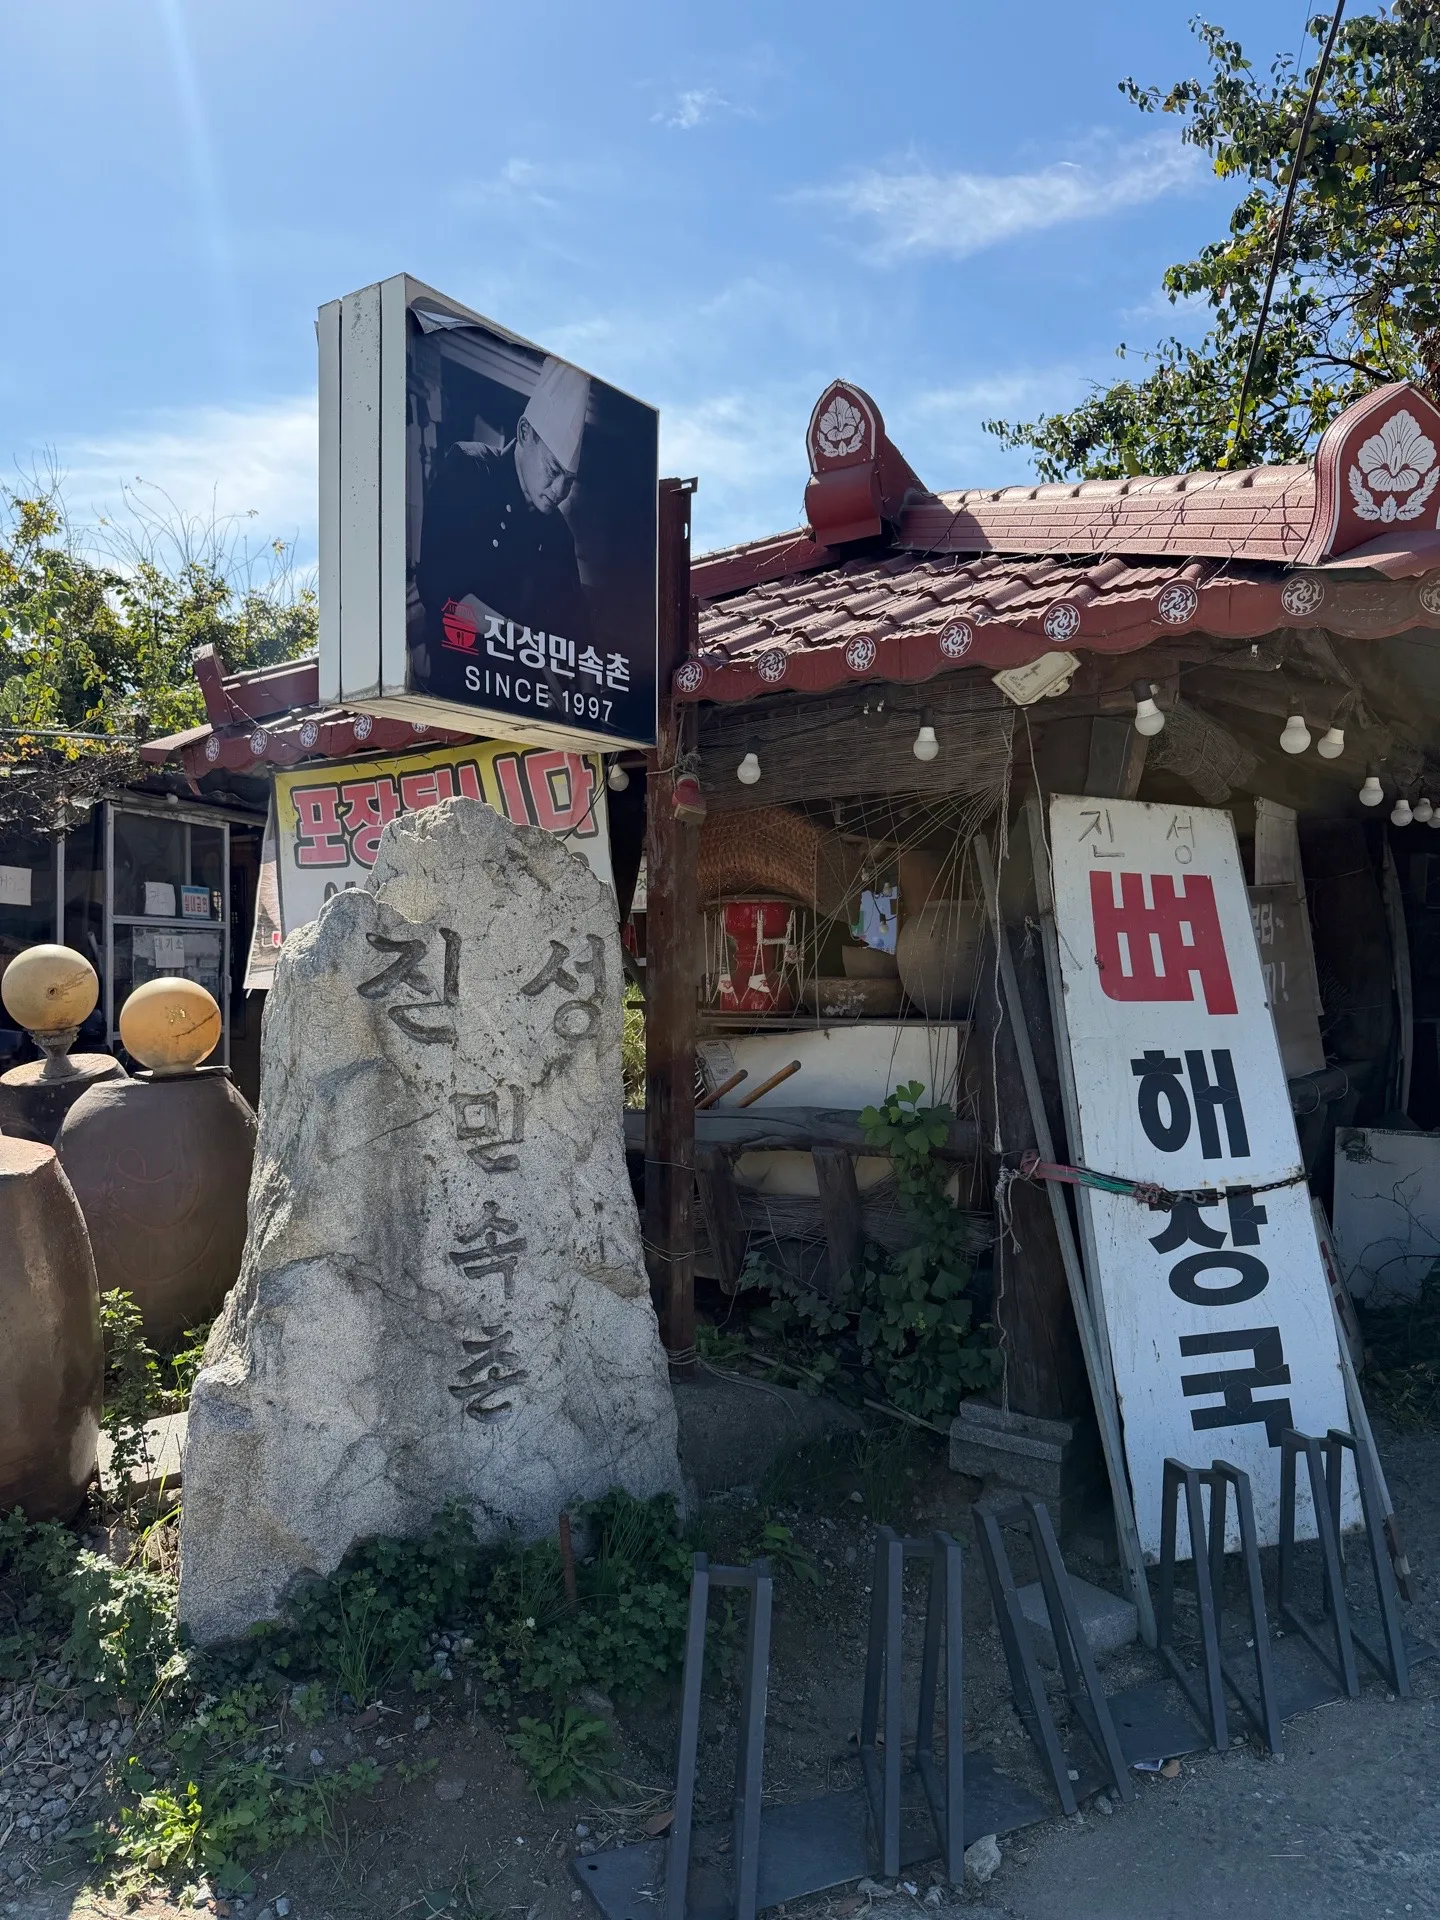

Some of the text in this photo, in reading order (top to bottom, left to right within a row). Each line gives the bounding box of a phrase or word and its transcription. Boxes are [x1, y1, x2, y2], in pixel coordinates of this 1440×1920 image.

[465, 665, 613, 722] SINCE 1997
[484, 614, 630, 693] 진성민속촌
[1077, 808, 1196, 865] 진성
[356, 927, 607, 1046] 진성
[1089, 870, 1294, 1449] 뼈해장국
[448, 1083, 529, 1425] 민속촌
